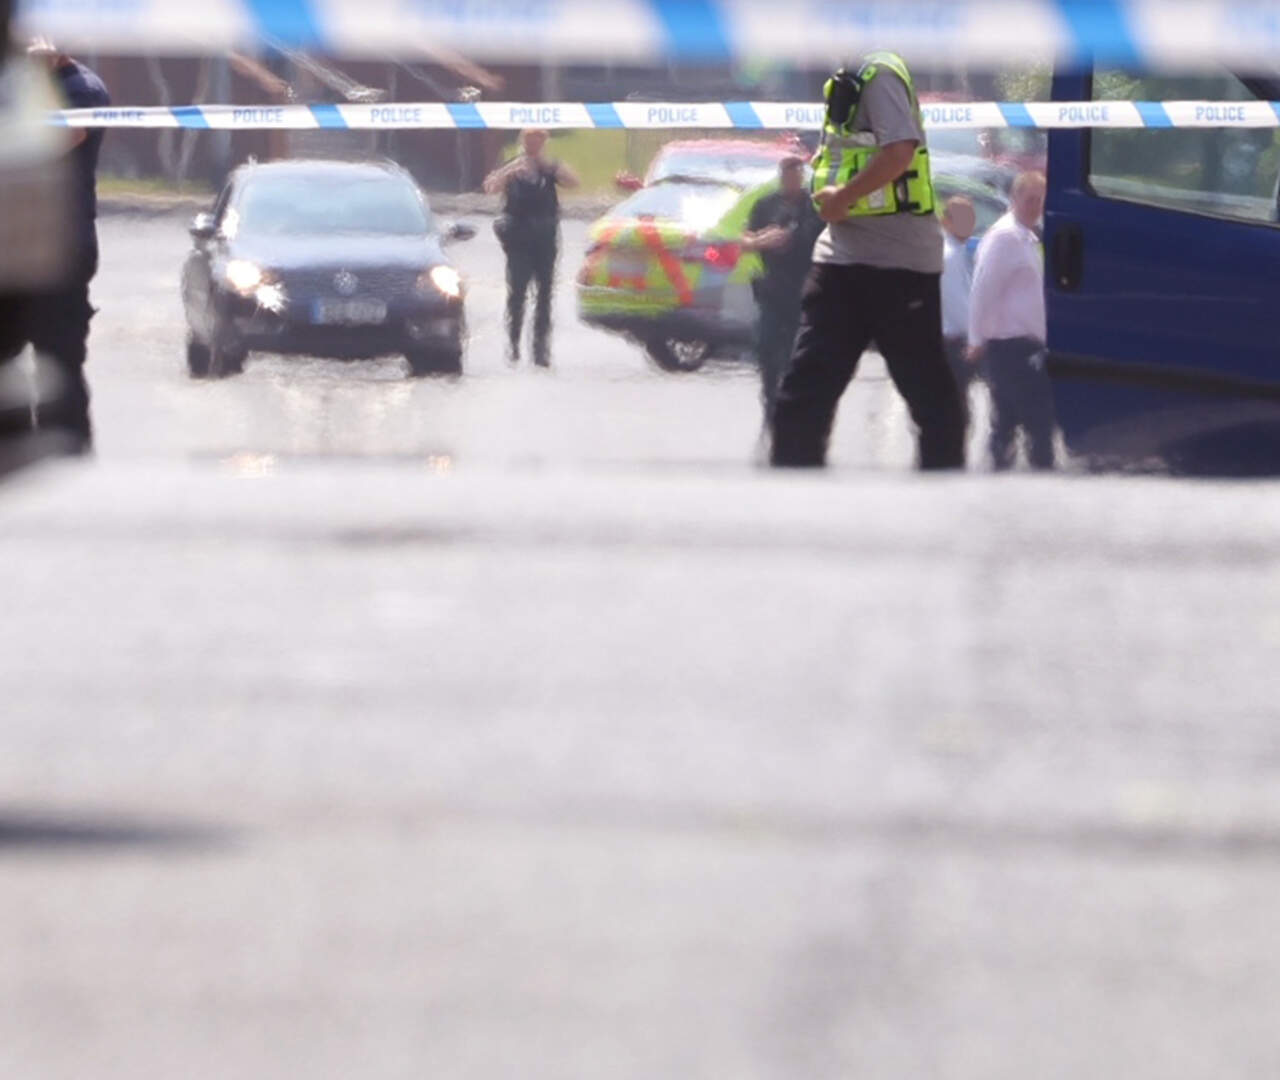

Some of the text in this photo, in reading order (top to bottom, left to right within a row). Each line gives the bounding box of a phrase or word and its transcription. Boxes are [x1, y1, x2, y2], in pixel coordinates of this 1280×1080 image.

[233, 108, 284, 124] POLICE
[370, 107, 421, 124] POLICE
[509, 107, 561, 123] POLICE
[648, 107, 699, 122] POLICE
[922, 107, 971, 122] POLICE
[1058, 106, 1109, 121] POLICE
[1195, 106, 1245, 121] POLICE
